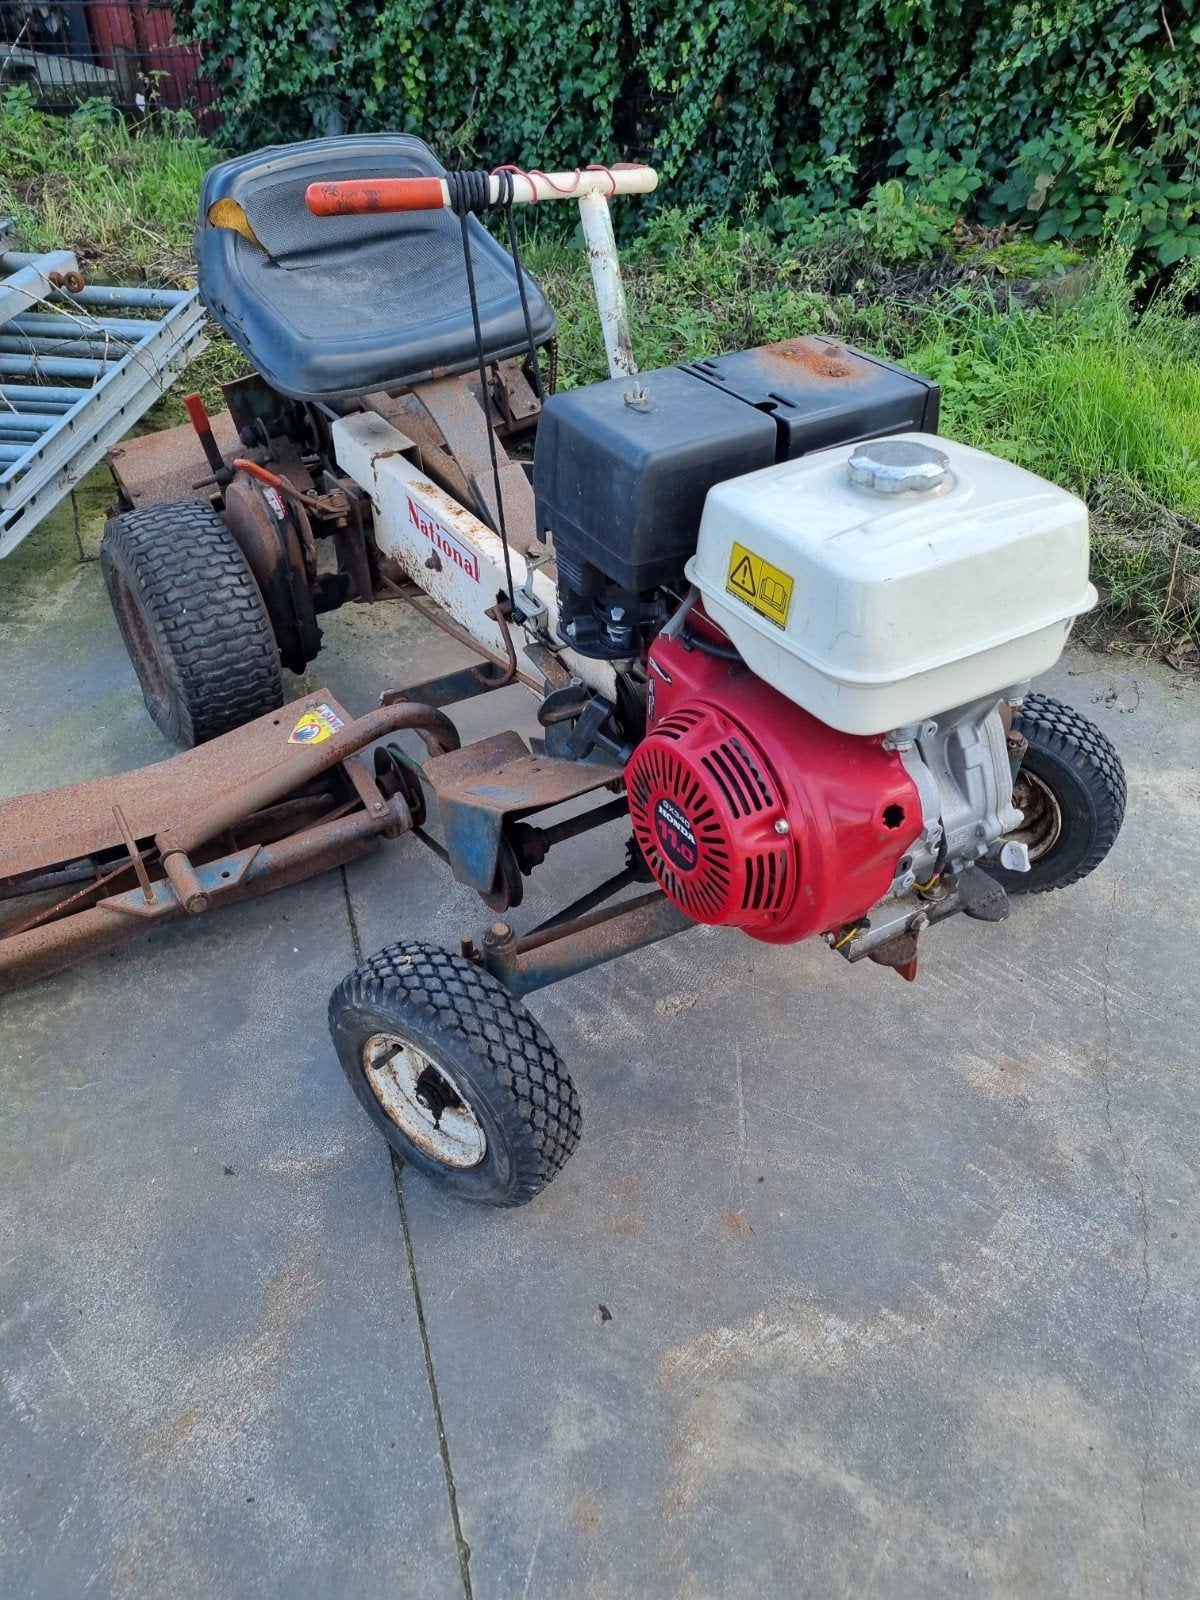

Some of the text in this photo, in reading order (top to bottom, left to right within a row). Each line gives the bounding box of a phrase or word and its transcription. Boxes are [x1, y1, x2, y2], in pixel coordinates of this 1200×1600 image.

[406, 495, 480, 584] National
[658, 805, 696, 845] HONDA
[662, 800, 690, 829] GX340
[658, 820, 694, 864] 11.0
